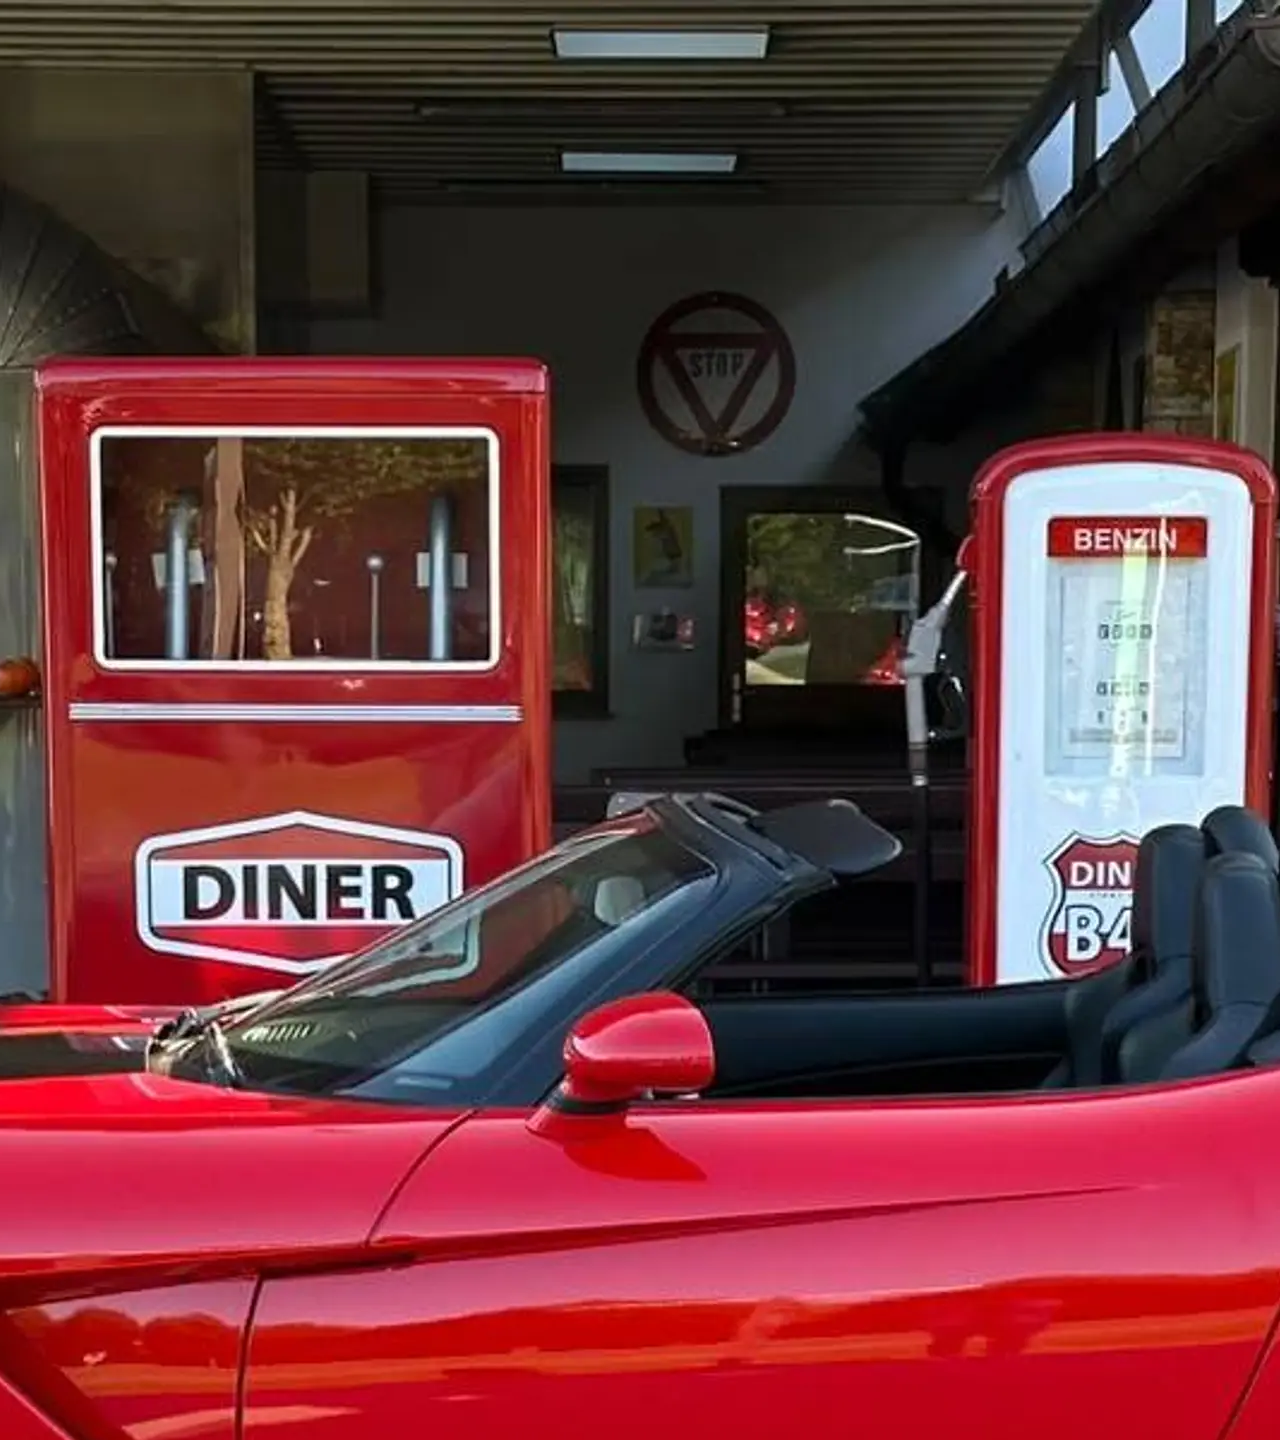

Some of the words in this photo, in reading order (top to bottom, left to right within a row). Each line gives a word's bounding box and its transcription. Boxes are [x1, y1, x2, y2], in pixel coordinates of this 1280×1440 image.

[689, 352, 744, 378] STOP
[1074, 527, 1178, 551] BENZIN
[1070, 861, 1132, 887] DIN
[182, 864, 415, 921] DINER
[1065, 904, 1133, 962] B4
